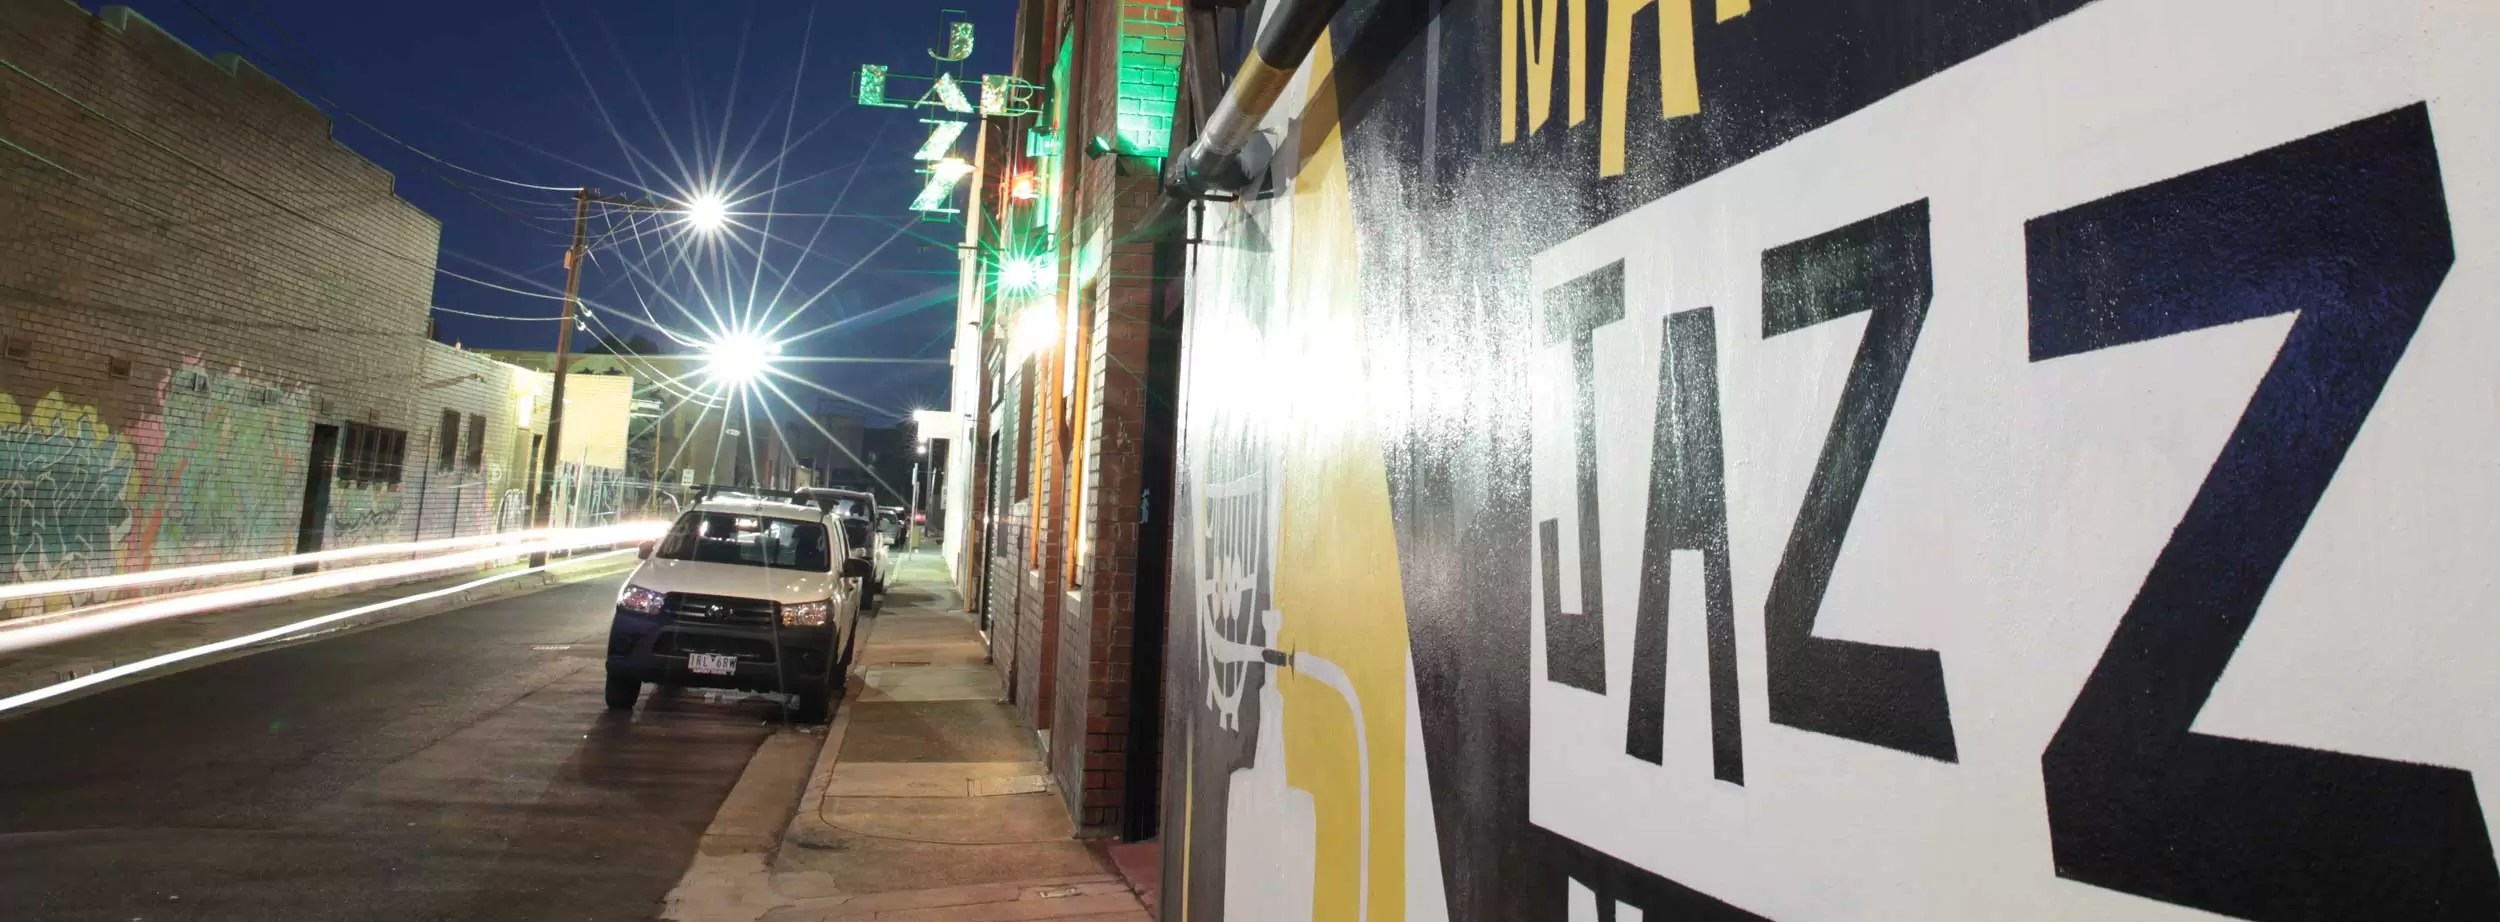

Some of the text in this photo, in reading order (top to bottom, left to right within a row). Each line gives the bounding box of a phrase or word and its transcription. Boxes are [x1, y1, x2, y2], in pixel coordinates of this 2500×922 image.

[858, 64, 1034, 117] LAB
[909, 21, 977, 213] JAZZ
[1538, 100, 2500, 922] JAZZ
